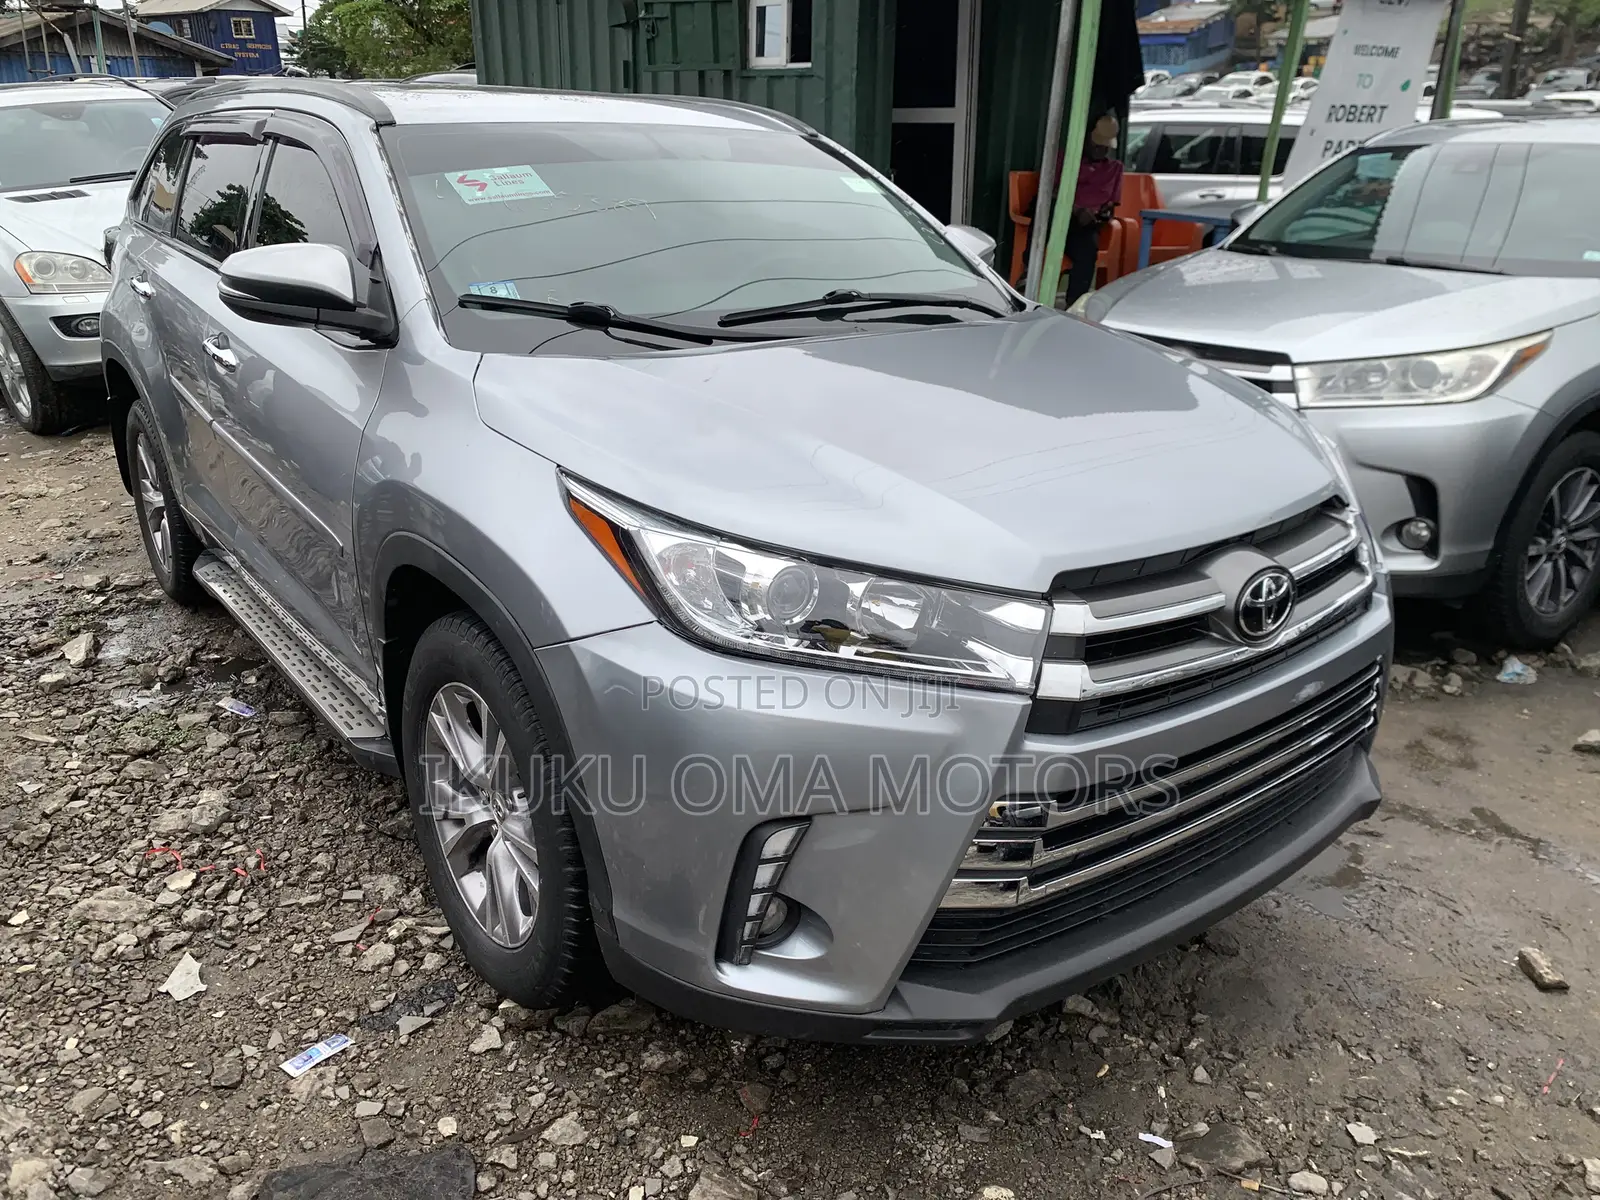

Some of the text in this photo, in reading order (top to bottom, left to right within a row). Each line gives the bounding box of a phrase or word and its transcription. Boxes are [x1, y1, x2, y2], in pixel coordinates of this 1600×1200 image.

[1354, 44, 1400, 59] WELCOME
[1356, 73, 1374, 90] TO
[1325, 104, 1388, 123] ROBERT
[490, 286, 497, 294] 8
